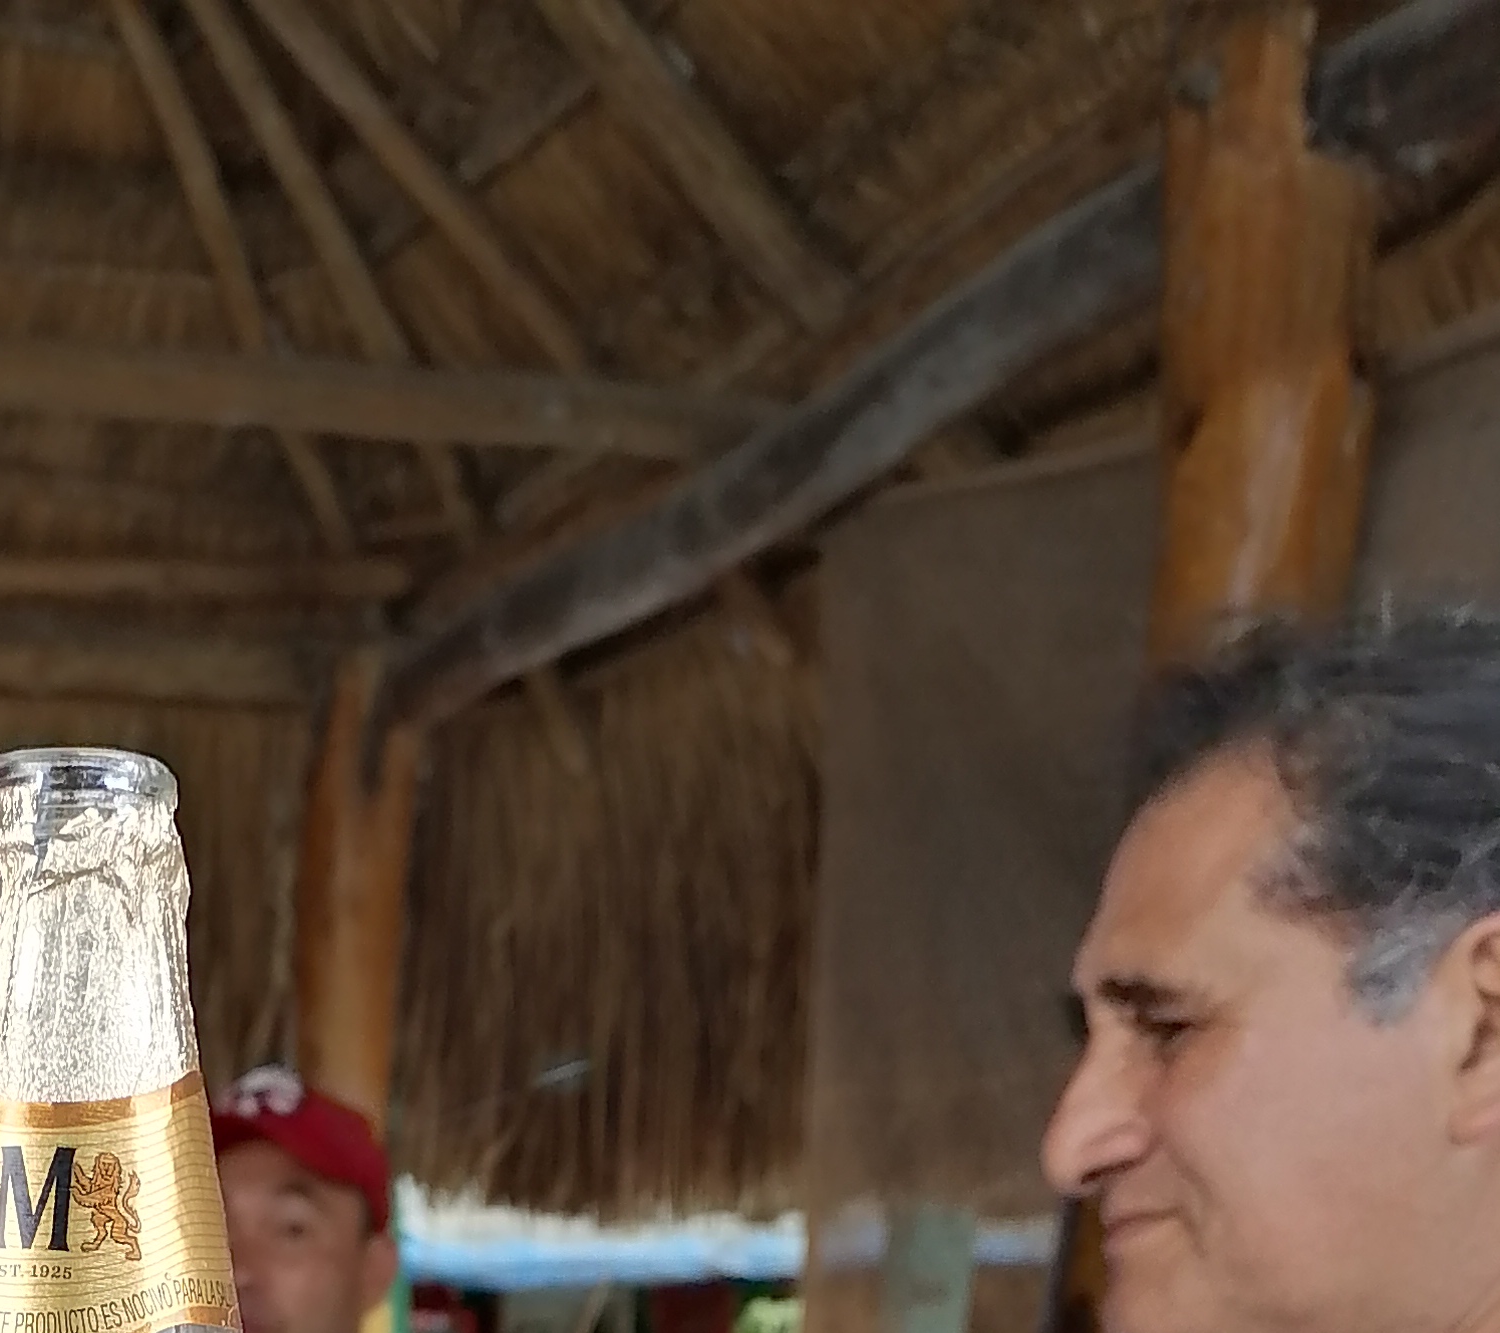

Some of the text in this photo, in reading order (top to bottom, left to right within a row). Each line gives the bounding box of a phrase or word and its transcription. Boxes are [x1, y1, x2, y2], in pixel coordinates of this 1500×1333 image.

[30, 1265, 72, 1280] 1925
[102, 1301, 123, 1331] ES
[121, 1281, 173, 1324] NOCIVO
[173, 1277, 204, 1306] PARA
[204, 1278, 217, 1306] LA
